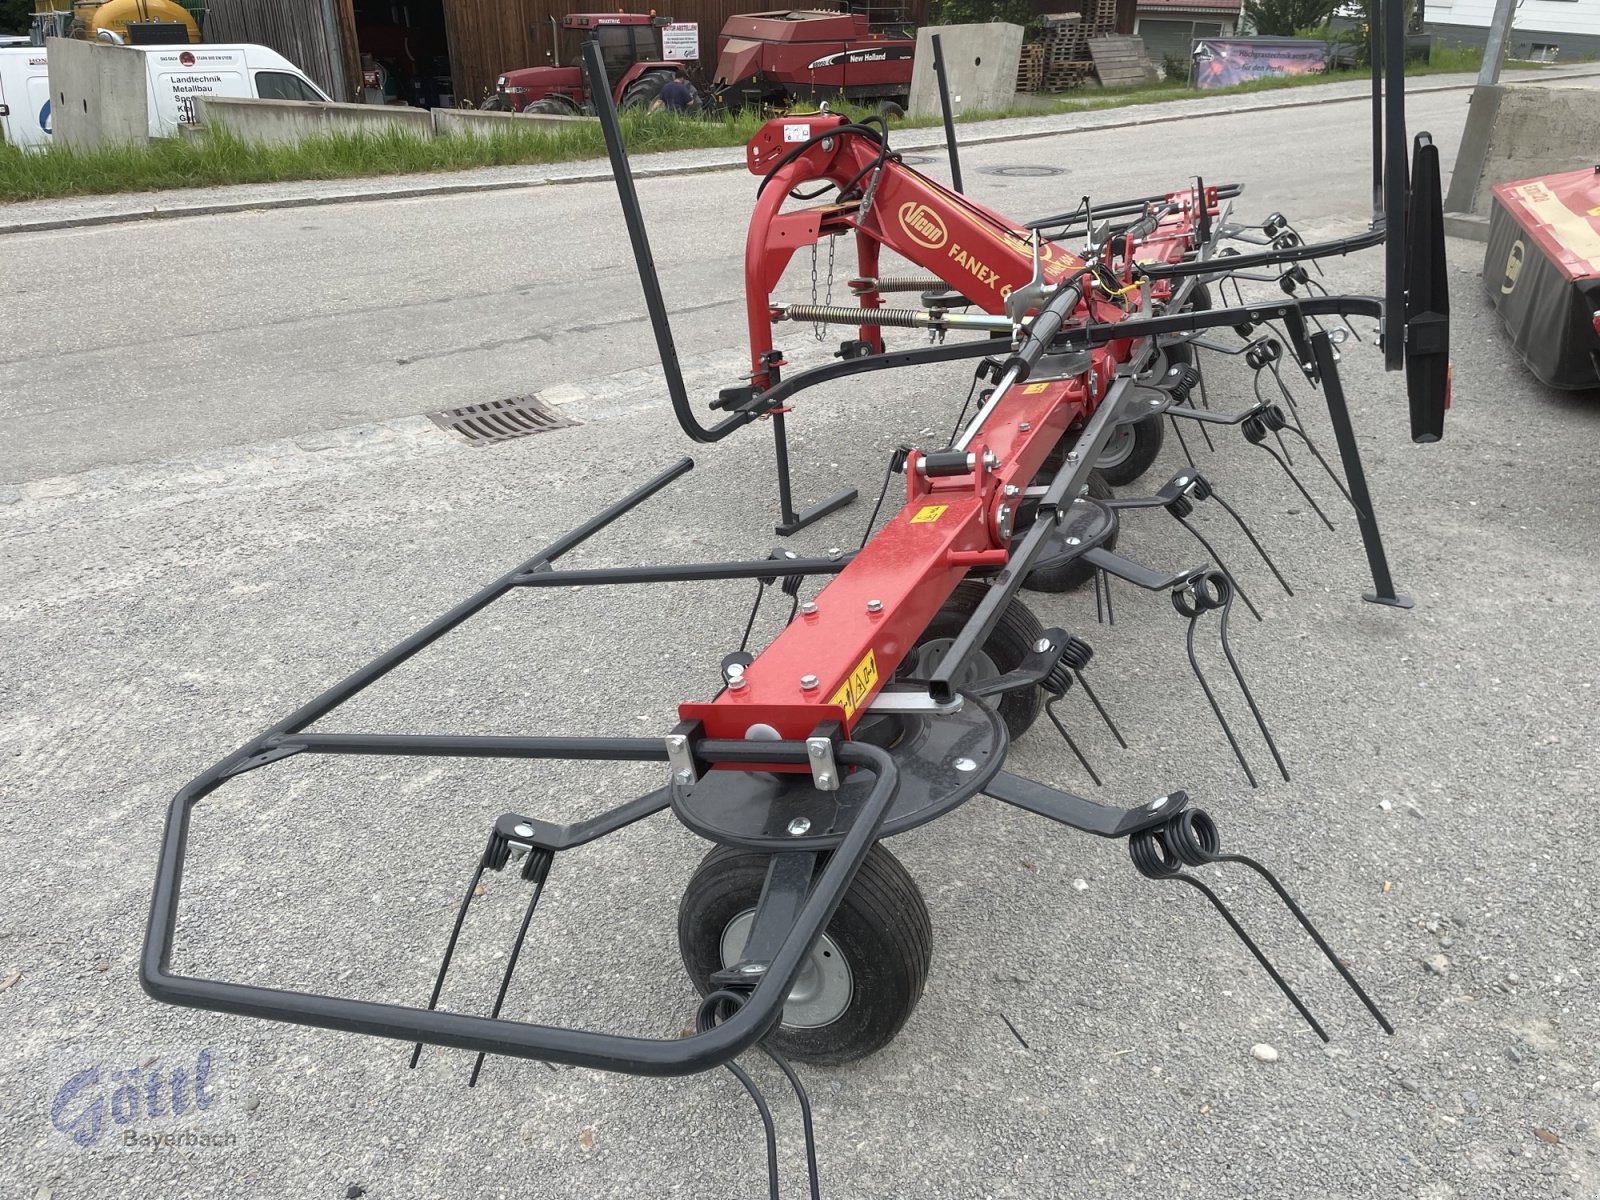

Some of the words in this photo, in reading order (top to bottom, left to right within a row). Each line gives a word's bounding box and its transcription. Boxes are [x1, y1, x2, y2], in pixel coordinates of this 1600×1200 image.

[849, 55, 863, 63] New
[864, 53, 886, 61] Holland
[170, 75, 222, 84] Landtechnik
[172, 85, 213, 93] Metallbau
[902, 202, 945, 244] Vicon
[948, 243, 1000, 290] FANEX
